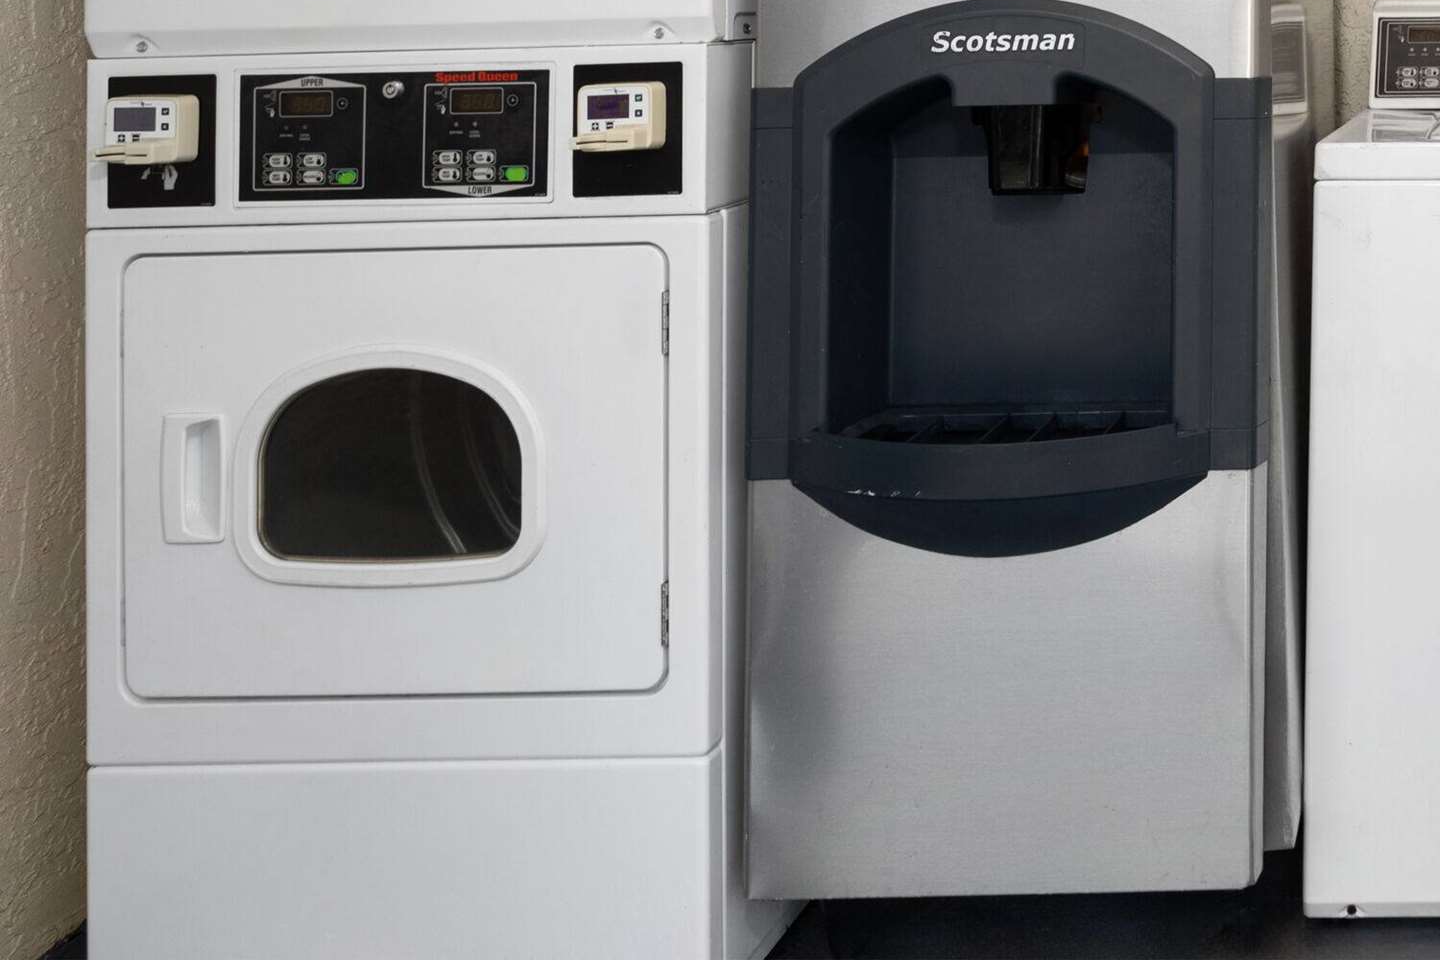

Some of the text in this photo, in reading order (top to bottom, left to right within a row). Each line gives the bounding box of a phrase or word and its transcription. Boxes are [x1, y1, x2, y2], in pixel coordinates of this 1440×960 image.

[930, 30, 1075, 53] Scotsman
[300, 78, 324, 87] UPPER
[435, 71, 519, 84] Speed Queen
[467, 186, 493, 194] LOWER
